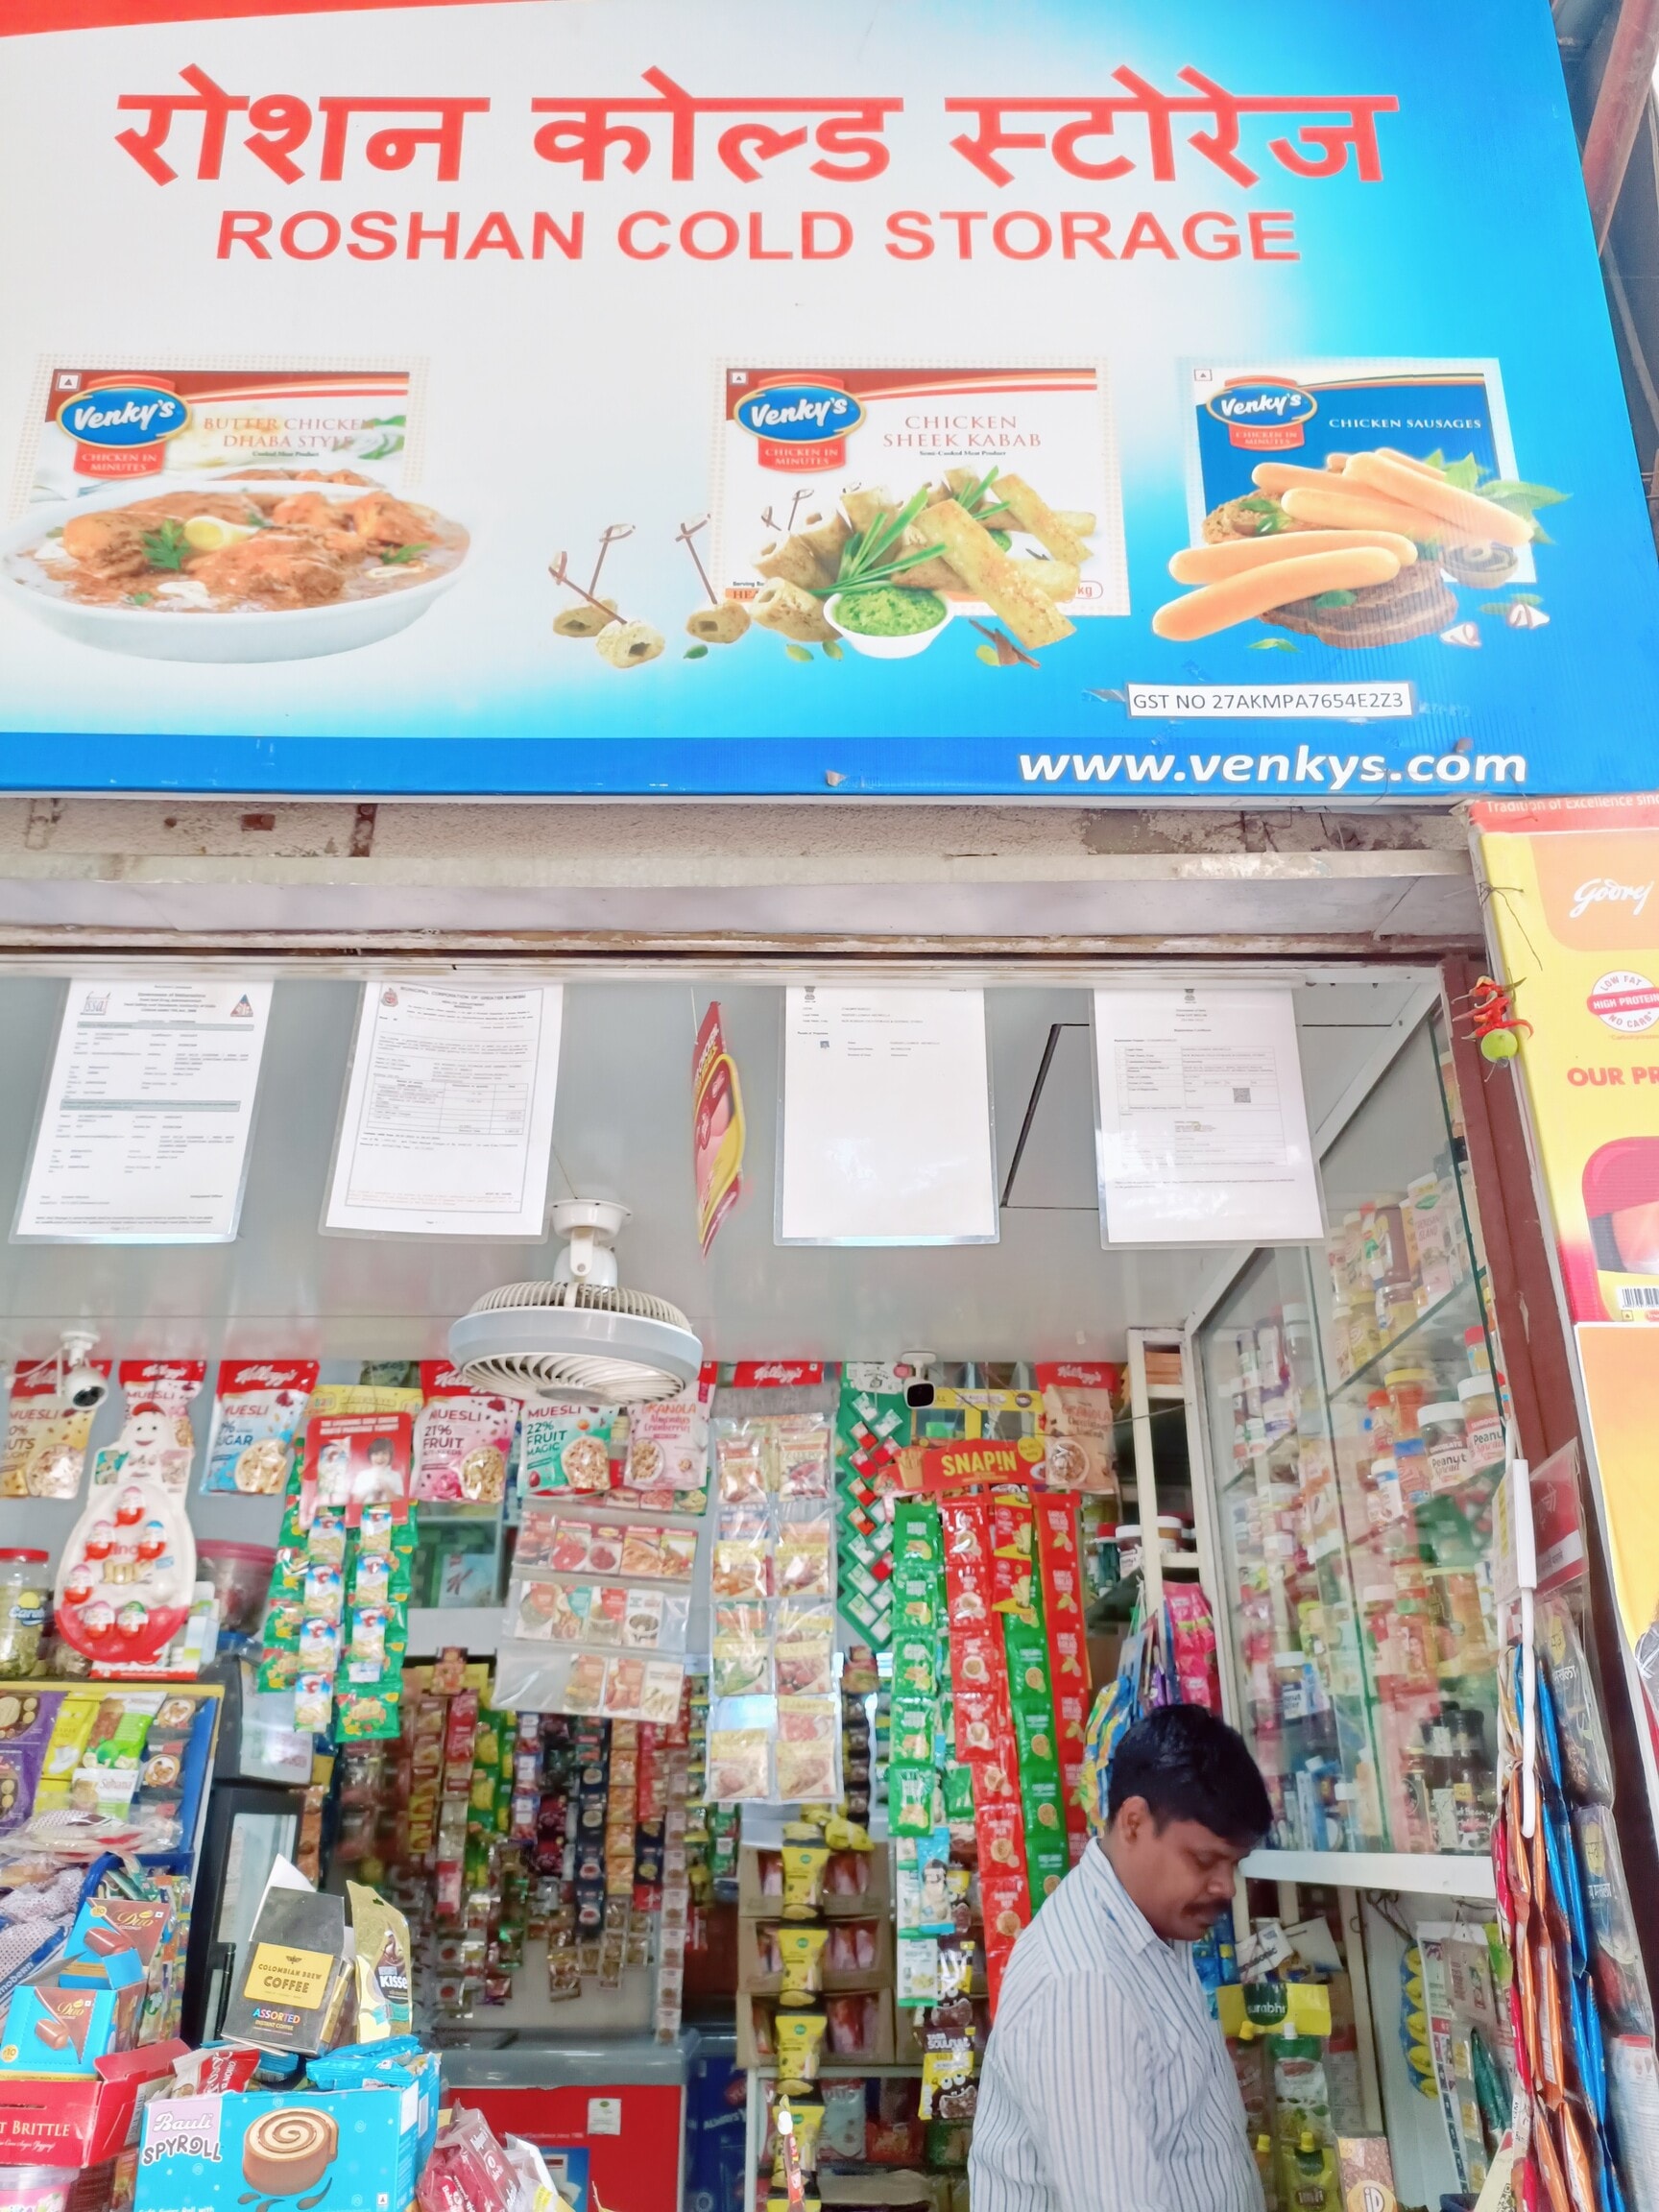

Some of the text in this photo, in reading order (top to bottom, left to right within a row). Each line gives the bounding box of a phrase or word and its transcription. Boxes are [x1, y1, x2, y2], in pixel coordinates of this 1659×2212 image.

[114, 63, 1400, 188] रोशन कोल्ड स्टोरेज
[216, 210, 1300, 261] ROSHAN COLD STORAGE
[1220, 391, 1303, 417] Venky's
[74, 397, 176, 431] Venky's
[751, 395, 850, 429] Venky's
[204, 418, 375, 431] BUTTER CHICKEN
[904, 416, 1018, 429] CHICKEN
[1329, 418, 1481, 430] CHICKEN SAUSAGES
[223, 435, 354, 448] DHABA STYLE
[882, 433, 1043, 447] SHEEK KABAB
[82, 453, 158, 465] CHICKEN IN
[765, 447, 838, 457] CHICKEN IN
[90, 463, 147, 474] MINUTES
[775, 456, 830, 467] MINUTES
[1133, 691, 1405, 711] GST NO 27AKMPA7654E2Z3
[1019, 745, 1527, 790] www.venkys.com
[1487, 800, 1547, 814] Tradition
[1550, 798, 1562, 810] of
[1566, 794, 1634, 810] Excellence
[1568, 878, 1655, 919] Godrej
[1599, 975, 1643, 992] LOW FAT
[1593, 998, 1617, 1010] HIGH
[1608, 1014, 1623, 1026] NO
[1567, 1069, 1626, 1088] OUR
[234, 1364, 299, 1387] Kellogg's
[429, 1409, 482, 1422] MUESLI
[528, 1405, 582, 1419] MUESLI
[424, 1425, 452, 1437] 21%
[527, 1421, 554, 1434] 22%
[422, 1437, 464, 1450] FRUIT
[527, 1430, 567, 1446] FRUIT
[527, 1442, 561, 1456] MAGIC
[941, 1450, 1018, 1478] SNAP!N
[1431, 1453, 1468, 1468] Peanut
[100, 1778, 134, 1791] Suhana
[258, 1962, 323, 1981] COLOMBIAN BREW
[263, 1975, 310, 1994] COFFEE
[1247, 2000, 1286, 2015] urabhi
[252, 2008, 301, 2025] ASSORTED
[12, 2120, 71, 2138] BRITTLE
[153, 2112, 214, 2132] Bauli
[142, 2133, 224, 2167] SPYROLL
